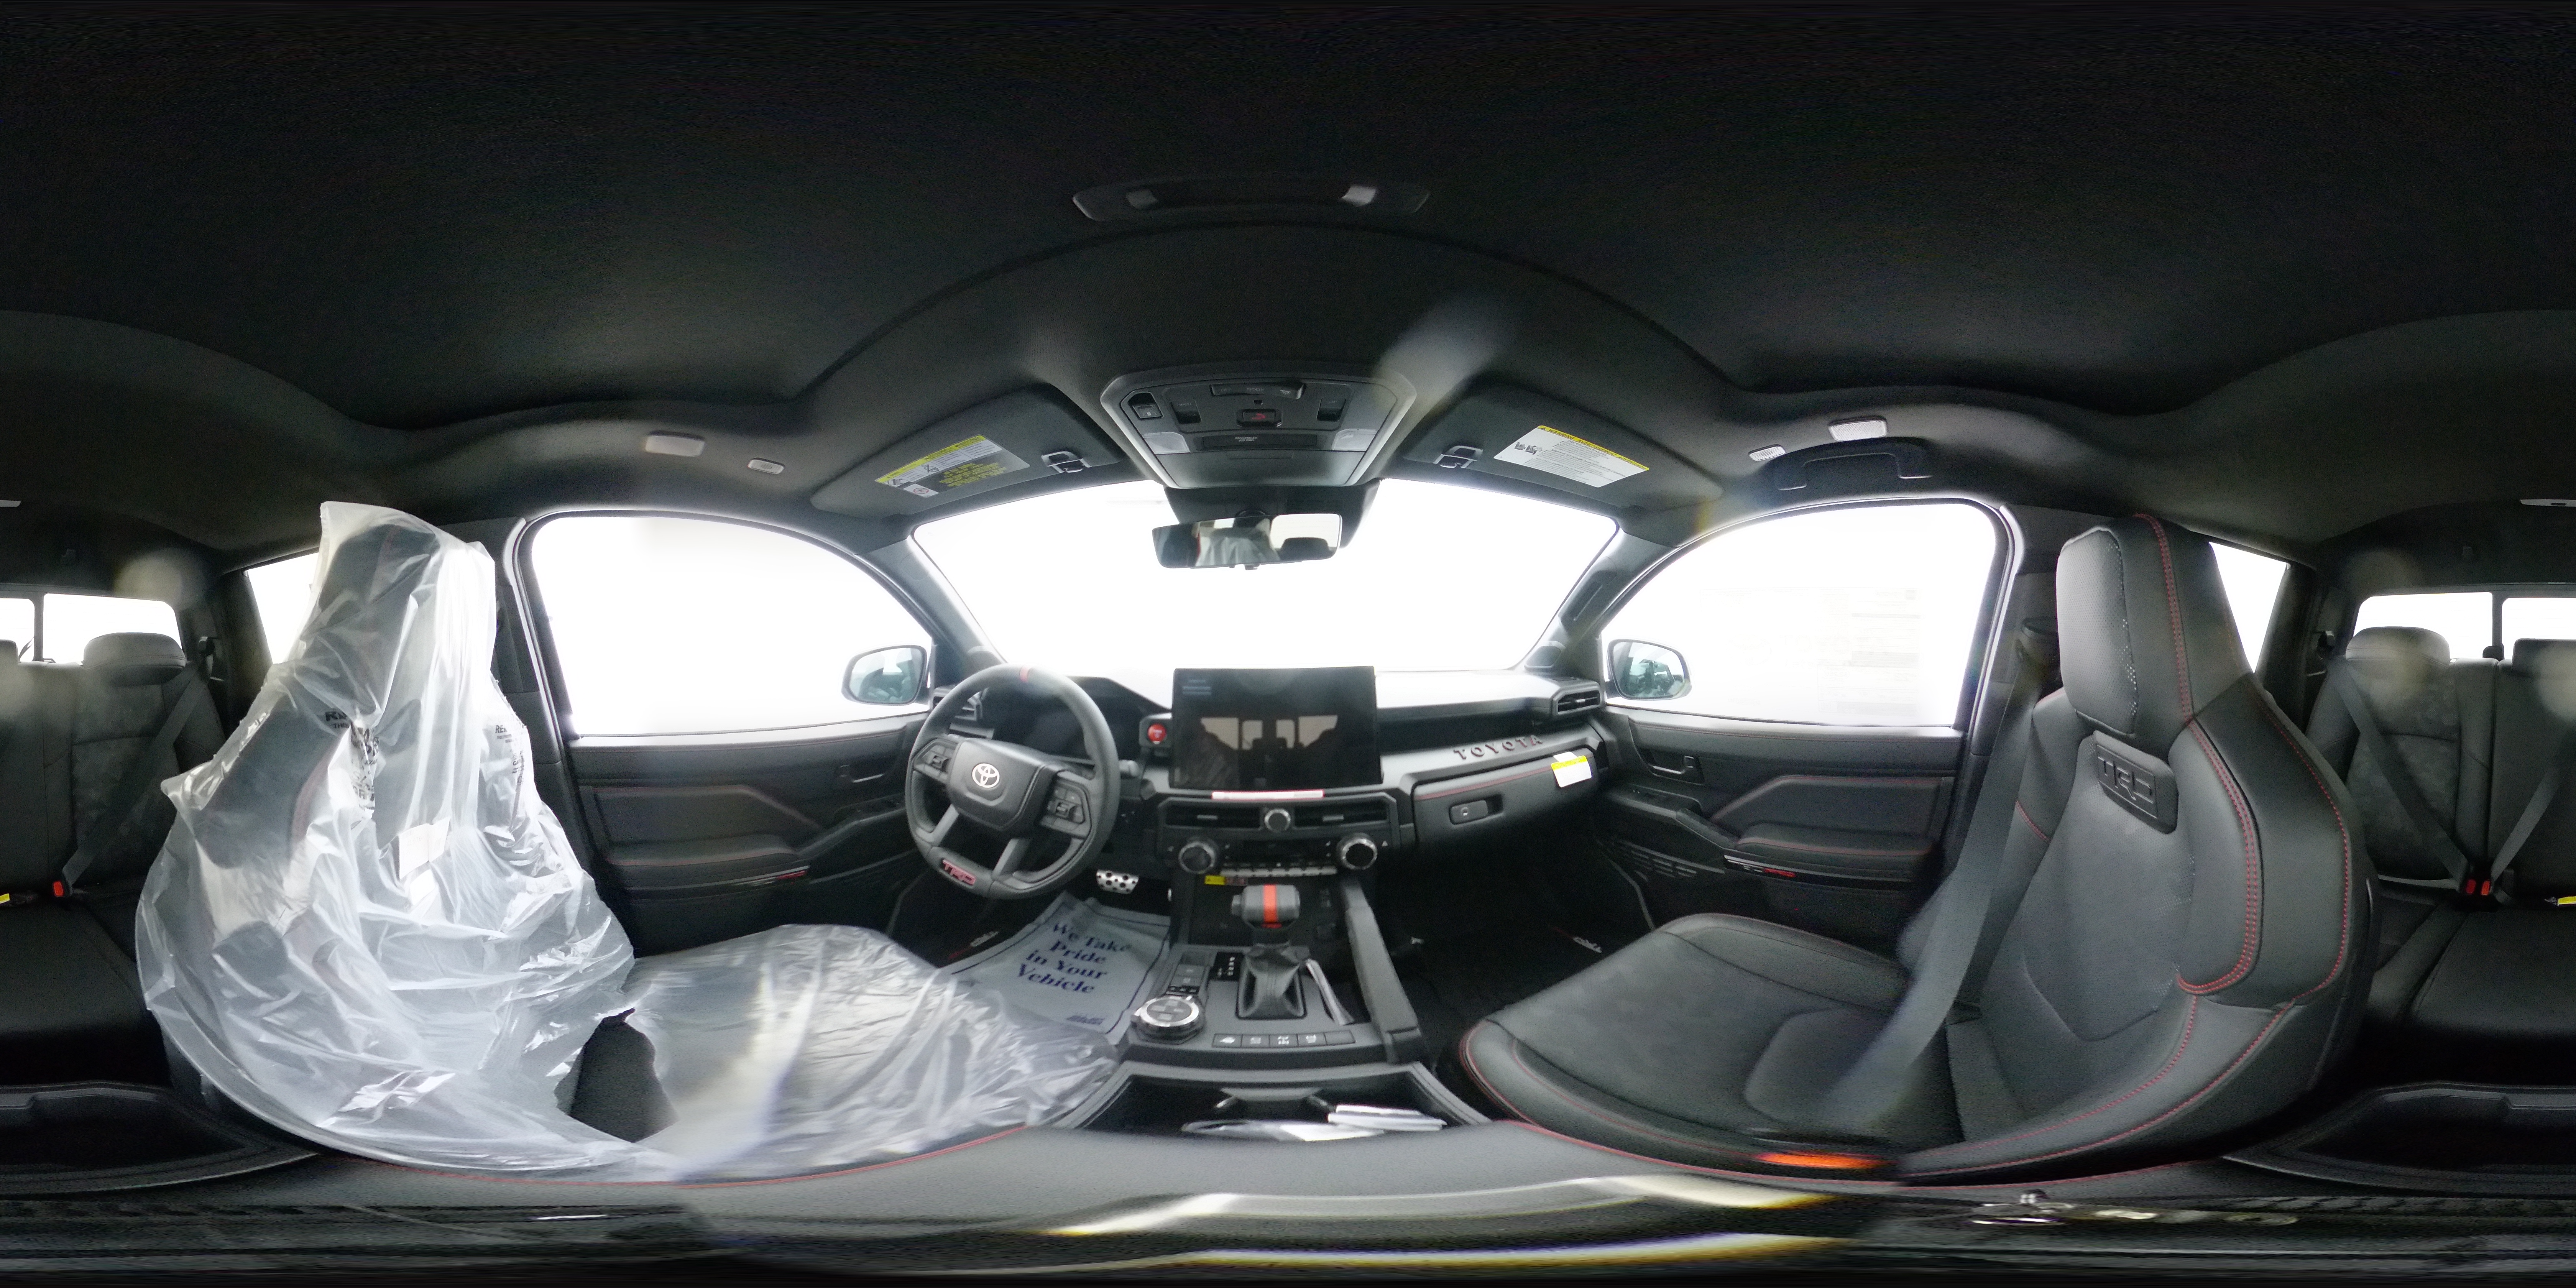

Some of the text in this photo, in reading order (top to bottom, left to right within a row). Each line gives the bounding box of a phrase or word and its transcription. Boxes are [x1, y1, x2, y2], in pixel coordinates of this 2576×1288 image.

[1548, 429, 1575, 440] WARNING
[1577, 439, 1617, 457] AVERTISSEMENT
[1452, 734, 1544, 761] TOYOTA
[2097, 756, 2154, 804] TRD
[942, 859, 976, 886] TRD
[1050, 940, 1106, 964] Pride
[1053, 922, 1130, 953] We Take
[1018, 963, 1096, 994] Vehicle
[1026, 949, 1108, 980] in Your
